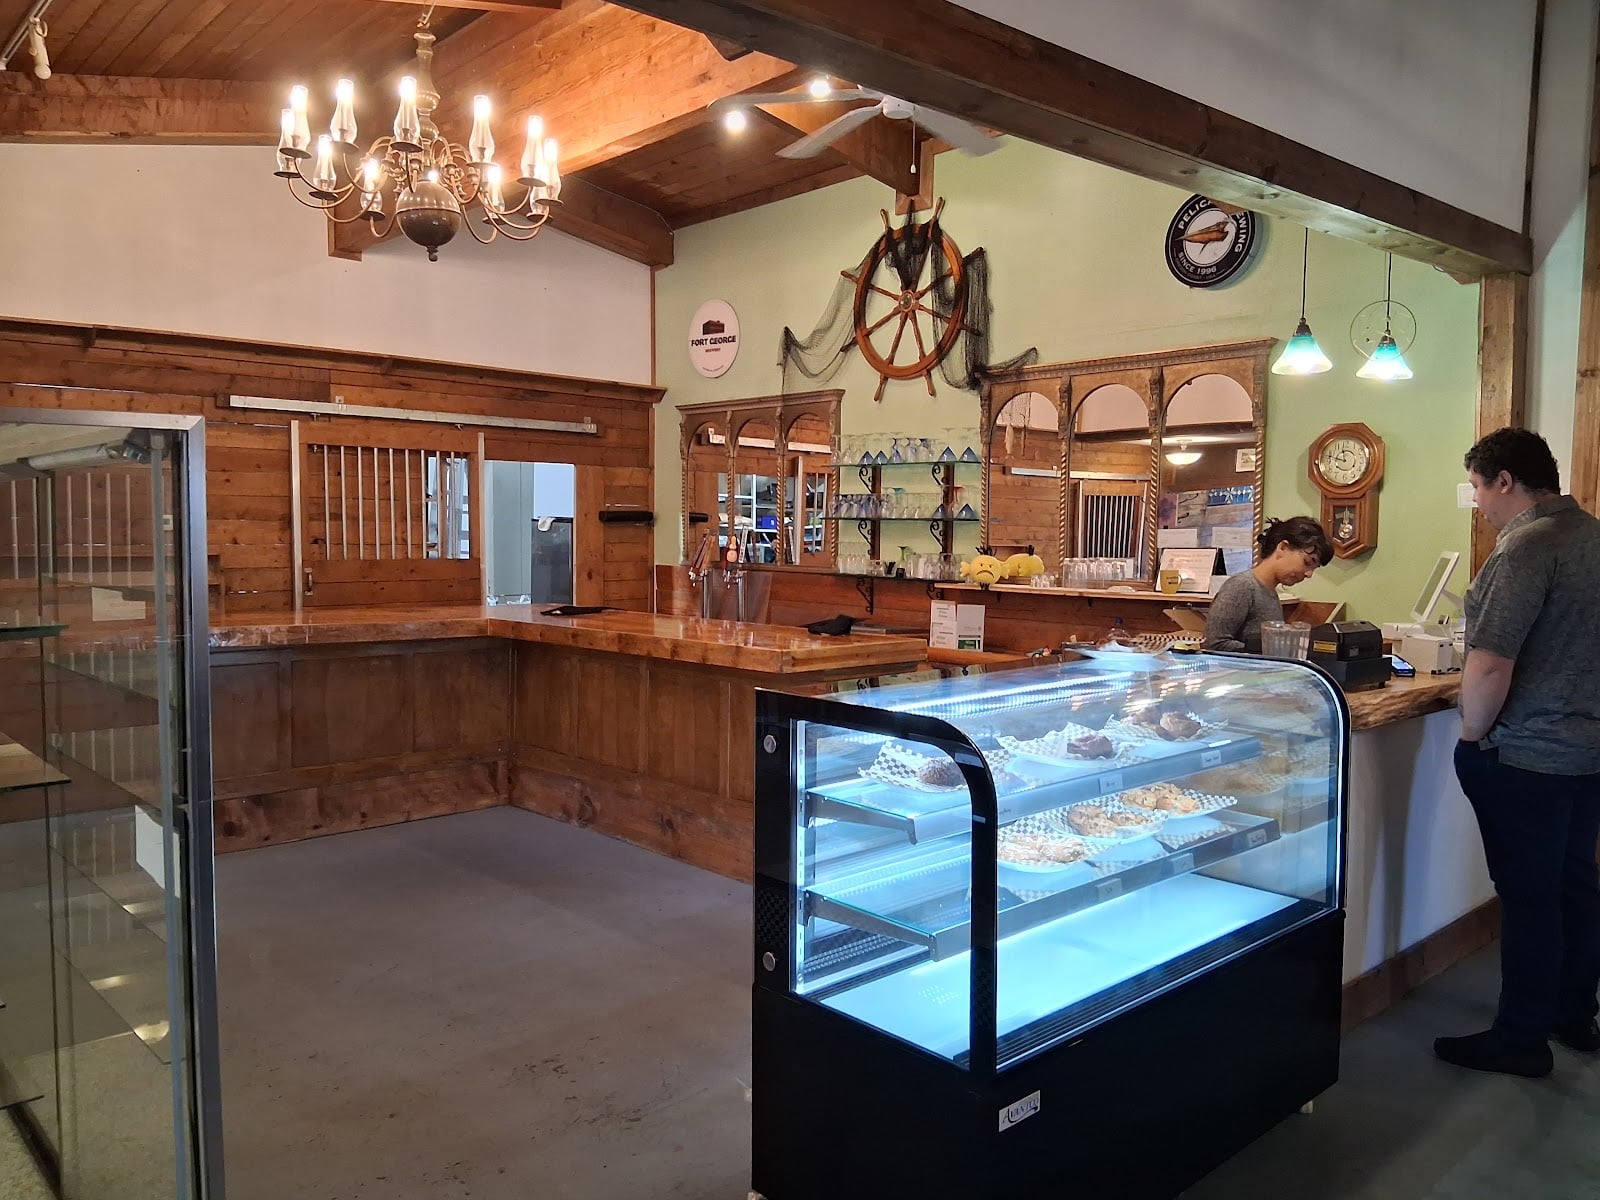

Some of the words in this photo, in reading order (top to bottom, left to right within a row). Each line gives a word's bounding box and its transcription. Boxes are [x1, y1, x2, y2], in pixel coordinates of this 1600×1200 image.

[1178, 199, 1213, 230] PELICA
[1234, 211, 1247, 253] EWING
[1178, 251, 1196, 273] SINCE
[1197, 265, 1217, 275] 1996
[690, 338, 708, 347] FORT
[709, 335, 737, 345] GEORGE
